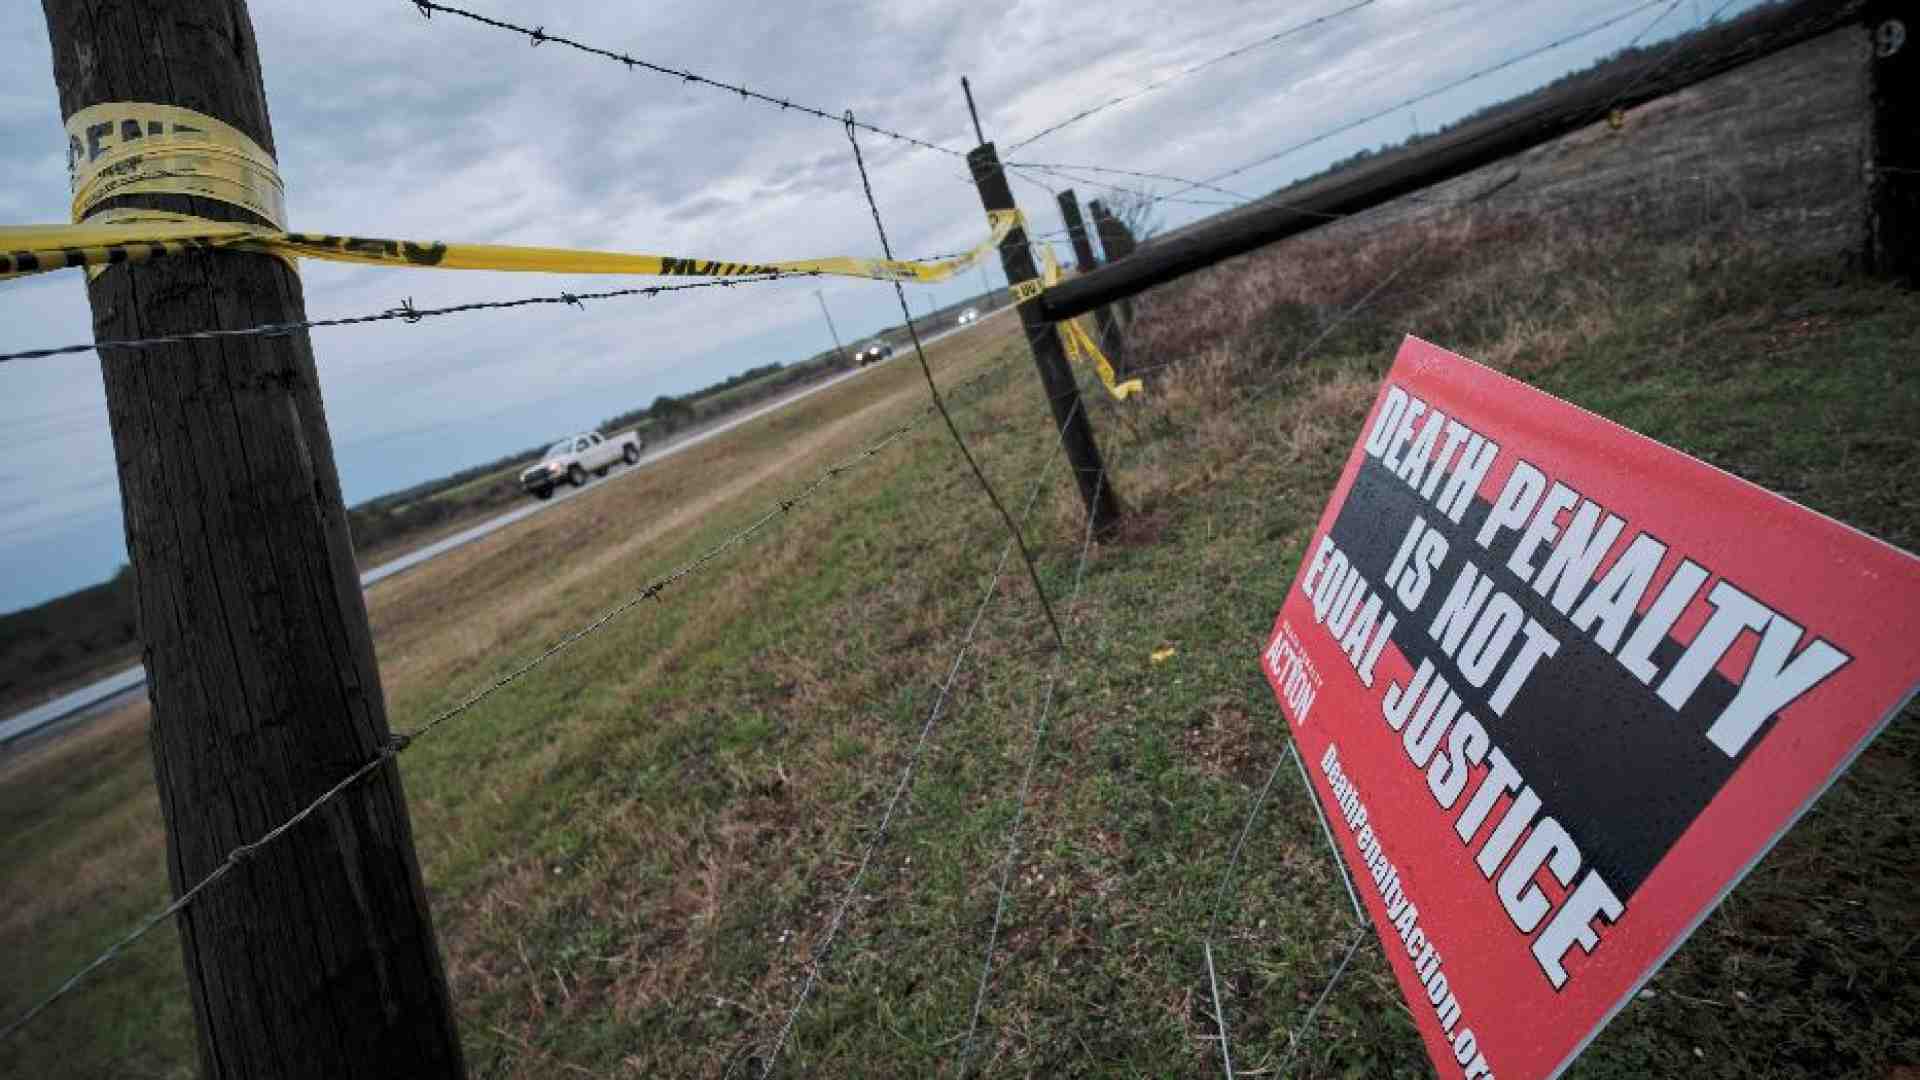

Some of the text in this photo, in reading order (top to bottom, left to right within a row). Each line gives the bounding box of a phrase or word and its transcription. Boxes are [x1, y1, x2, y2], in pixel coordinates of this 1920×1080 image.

[1265, 630, 1317, 726] ACTION
[1364, 384, 1854, 758] DEATH PENALTY
[1384, 515, 1450, 612] IS
[1428, 560, 1561, 718] NOT
[1302, 534, 1626, 992] EQUAL JUSTICE
[1321, 742, 1495, 1080] DeathPenaltyAction.or
